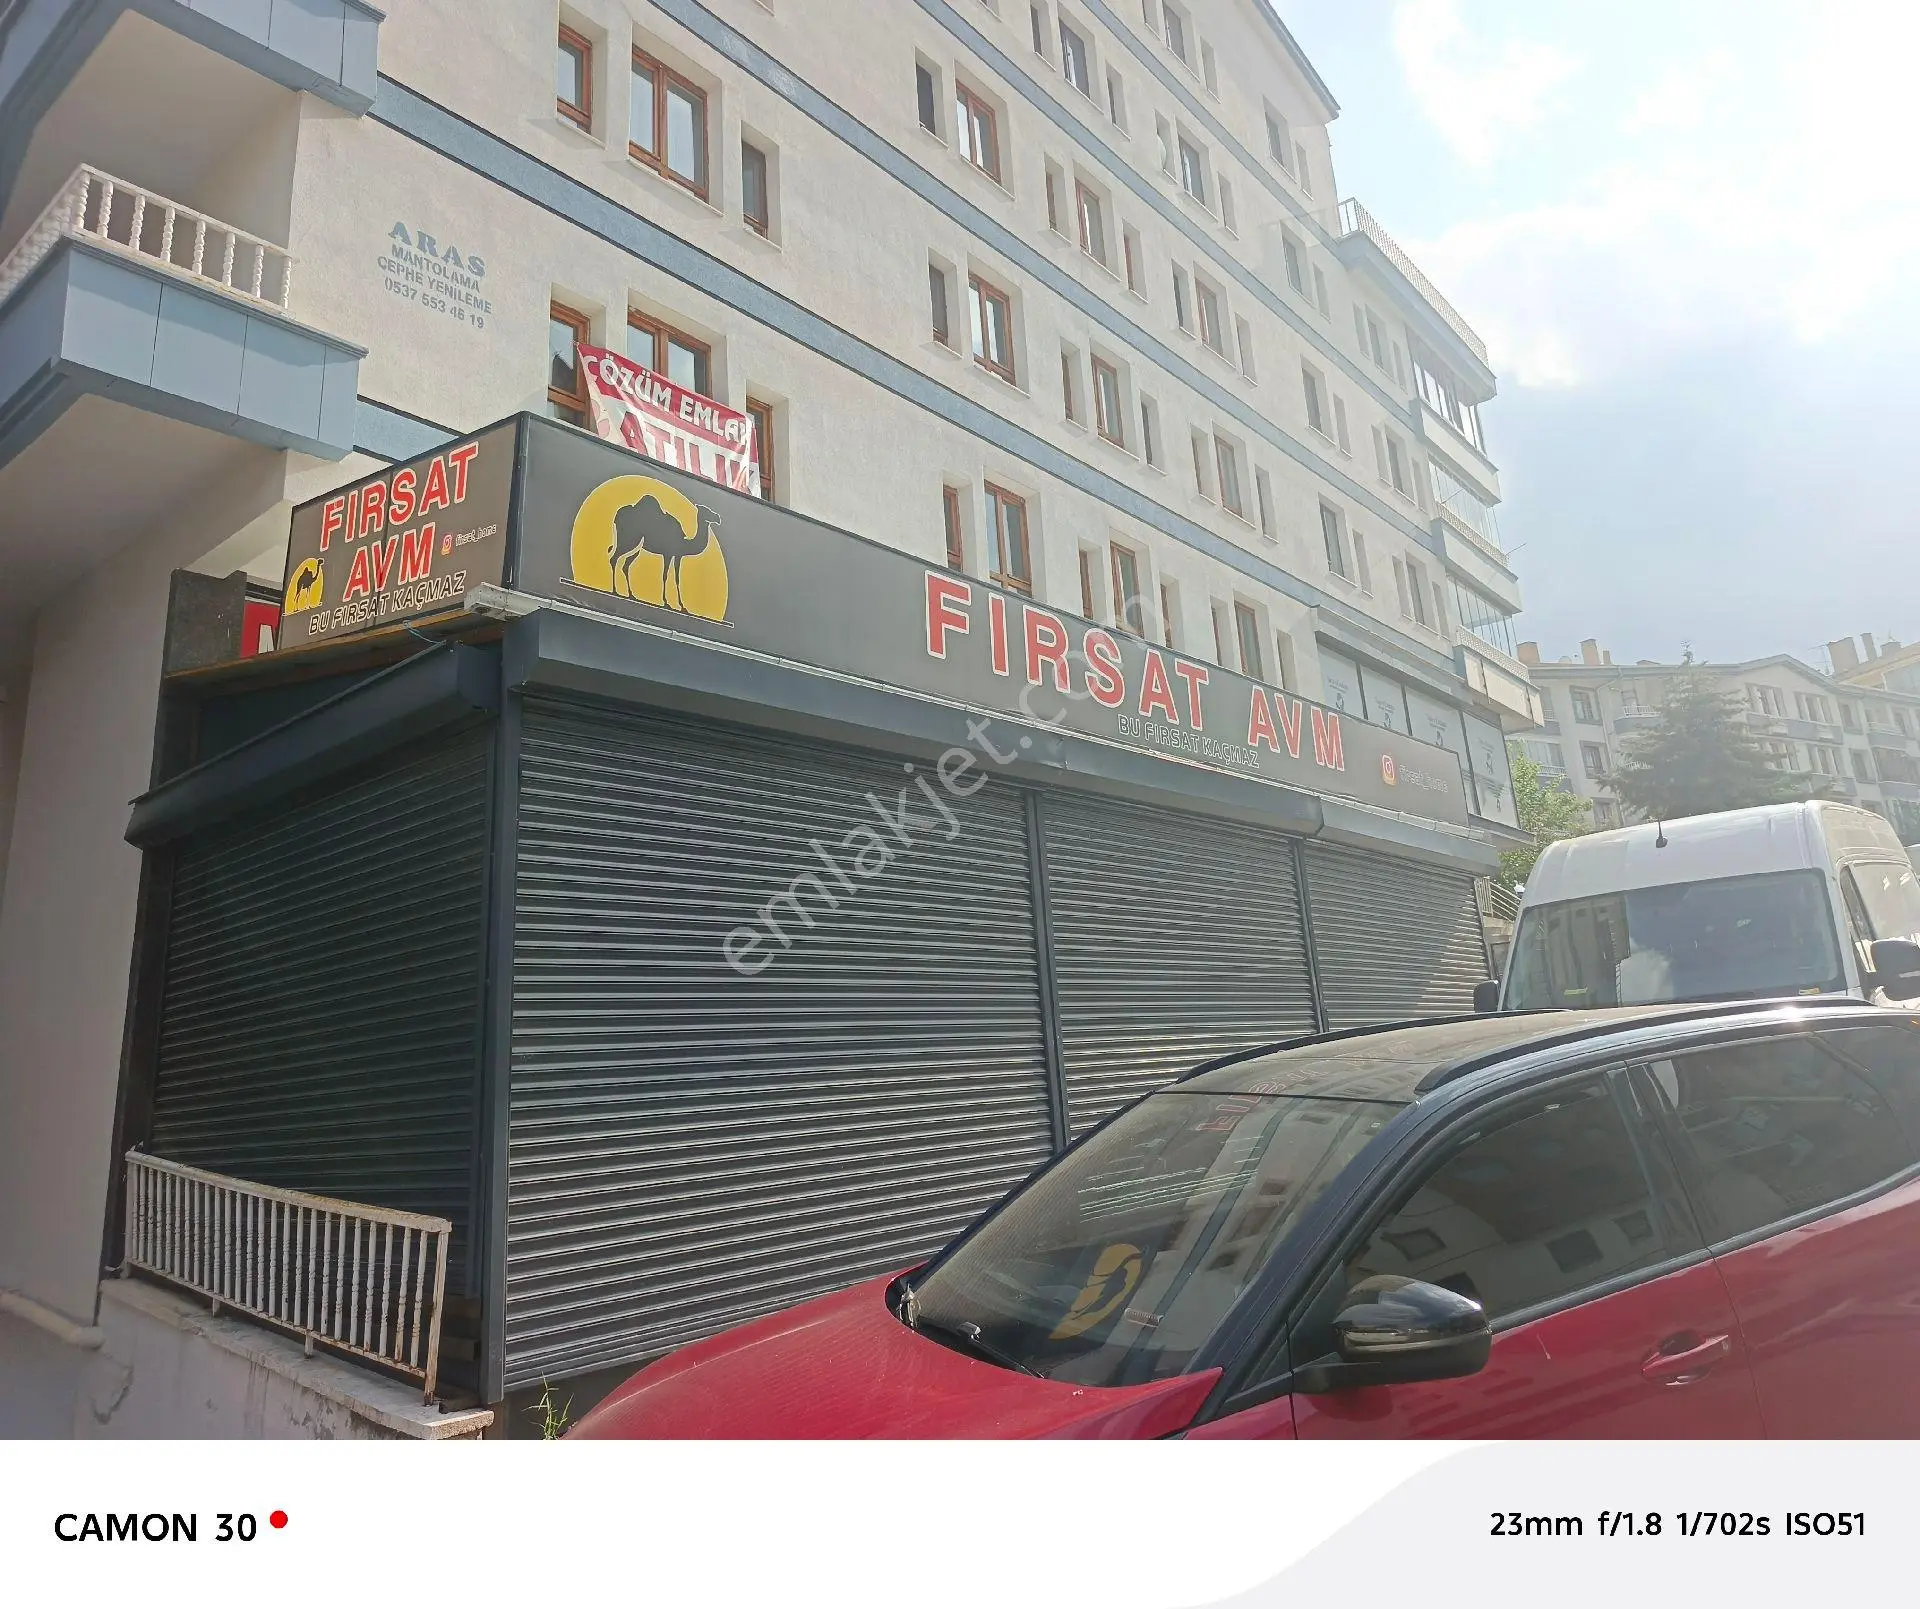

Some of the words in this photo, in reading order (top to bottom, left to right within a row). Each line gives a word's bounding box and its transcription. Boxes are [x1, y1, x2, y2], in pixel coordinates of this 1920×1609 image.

[388, 221, 486, 278] ARAS
[391, 243, 481, 294] MANTOLAMA
[377, 255, 424, 286] CEPHE
[427, 275, 493, 314] YENİLEME
[384, 276, 418, 301] 0537
[469, 314, 485, 329] 19
[319, 441, 479, 552] FIRSAT
[342, 521, 436, 603] AVM
[308, 610, 331, 636] BU
[332, 592, 391, 630] FIRSAT
[391, 569, 467, 612] KAÇMAZ
[924, 570, 1210, 732] FIRSAT
[1246, 684, 1346, 773] AVM
[1117, 713, 1141, 738] BU
[1143, 721, 1200, 754] FIRSAT
[1201, 736, 1260, 770] KAÇMAZ
